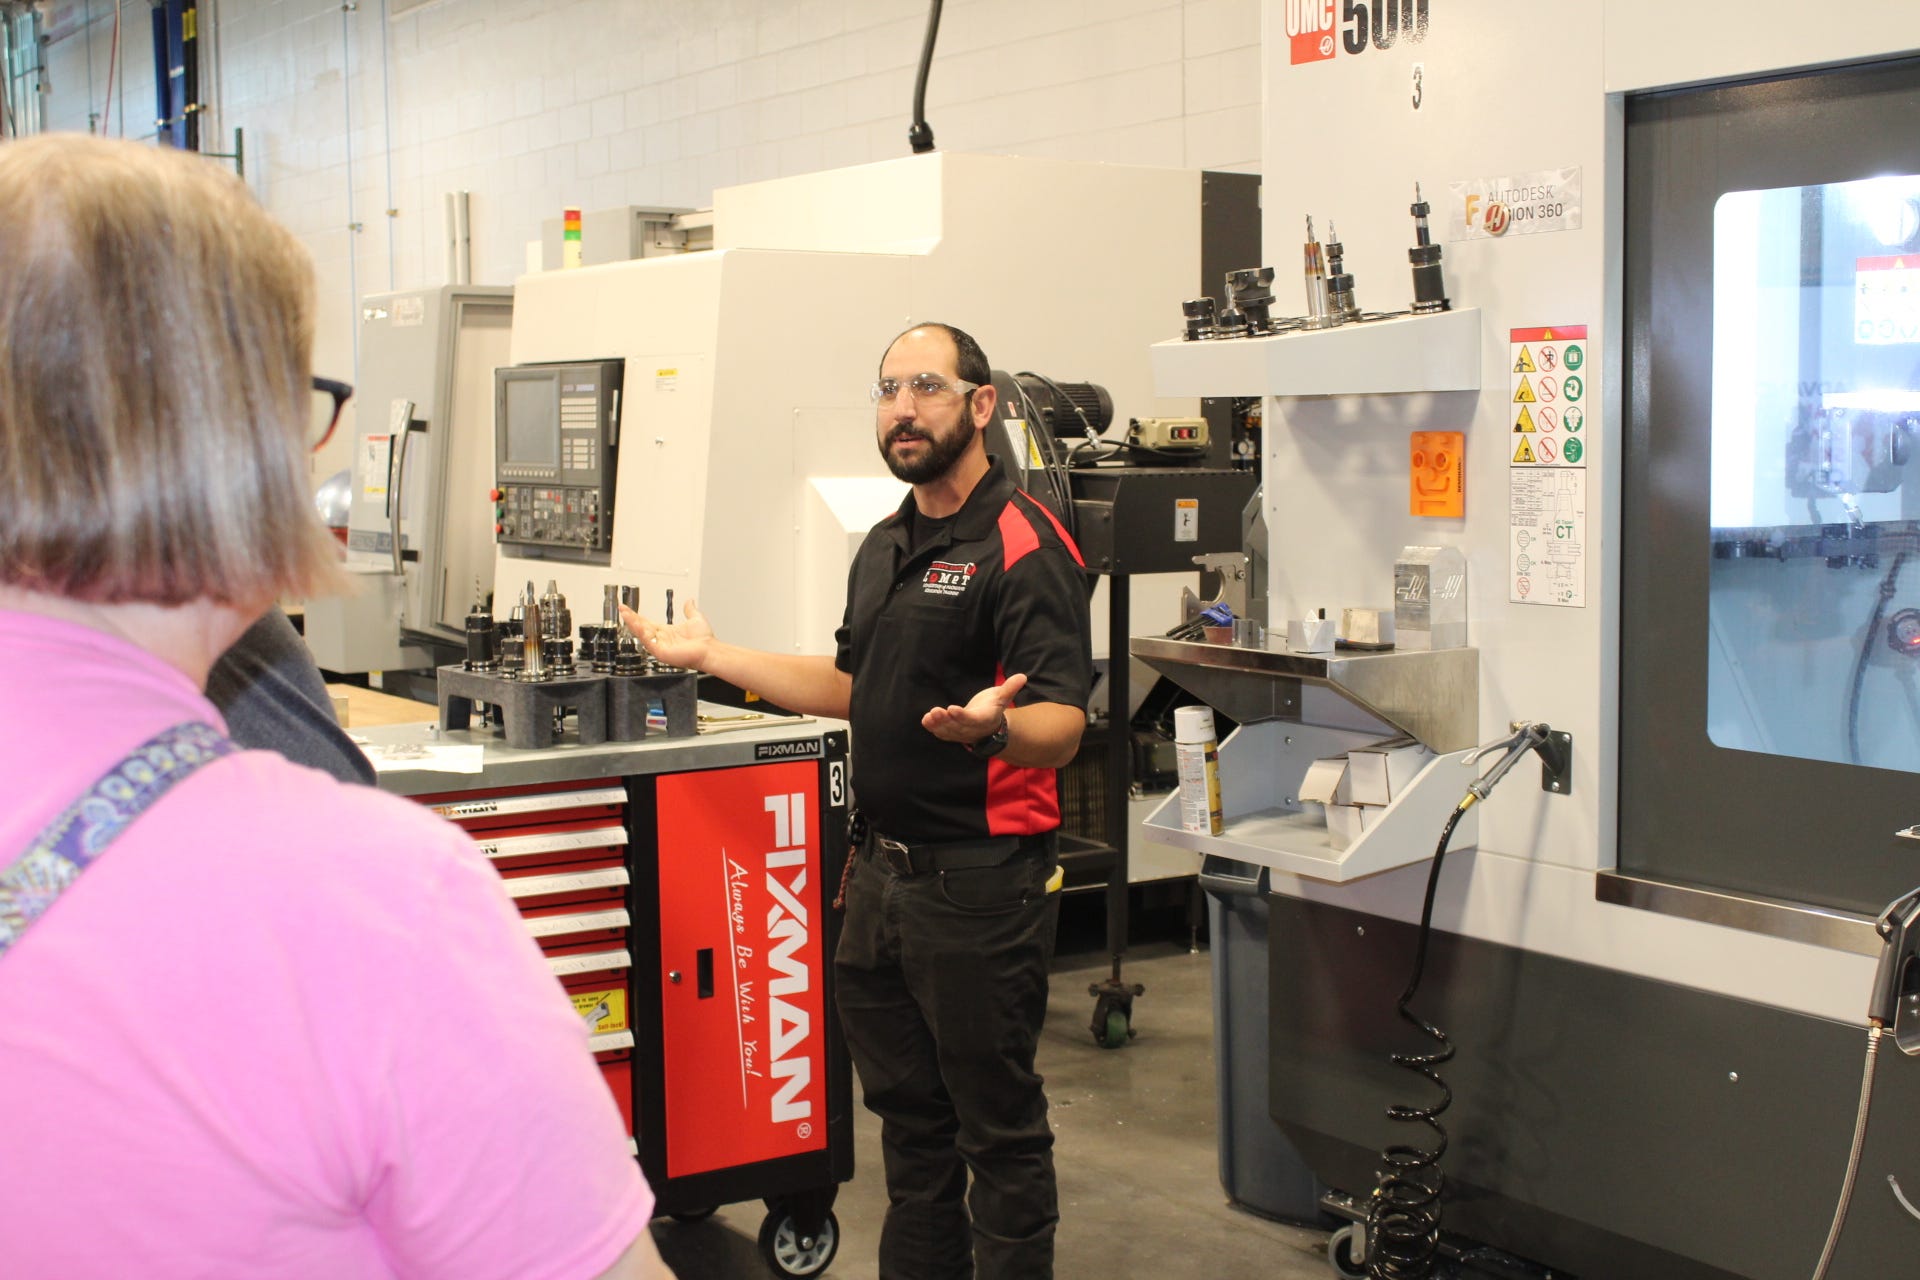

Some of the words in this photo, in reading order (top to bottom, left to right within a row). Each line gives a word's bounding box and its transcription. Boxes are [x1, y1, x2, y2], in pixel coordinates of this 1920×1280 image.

[1286, 0, 1333, 37] UMC
[1342, 0, 1429, 55] 500
[1412, 66, 1422, 109] 3
[1488, 185, 1554, 204] AUTODESK
[1538, 203, 1563, 219] 360
[1556, 525, 1574, 539] CT
[758, 742, 819, 757] FIXMAN
[832, 765, 842, 803] 3
[728, 858, 749, 935] Always
[736, 944, 753, 969] Be
[764, 792, 812, 1123] FIXMAN
[739, 981, 755, 1024] With
[743, 1040, 763, 1077] You!
